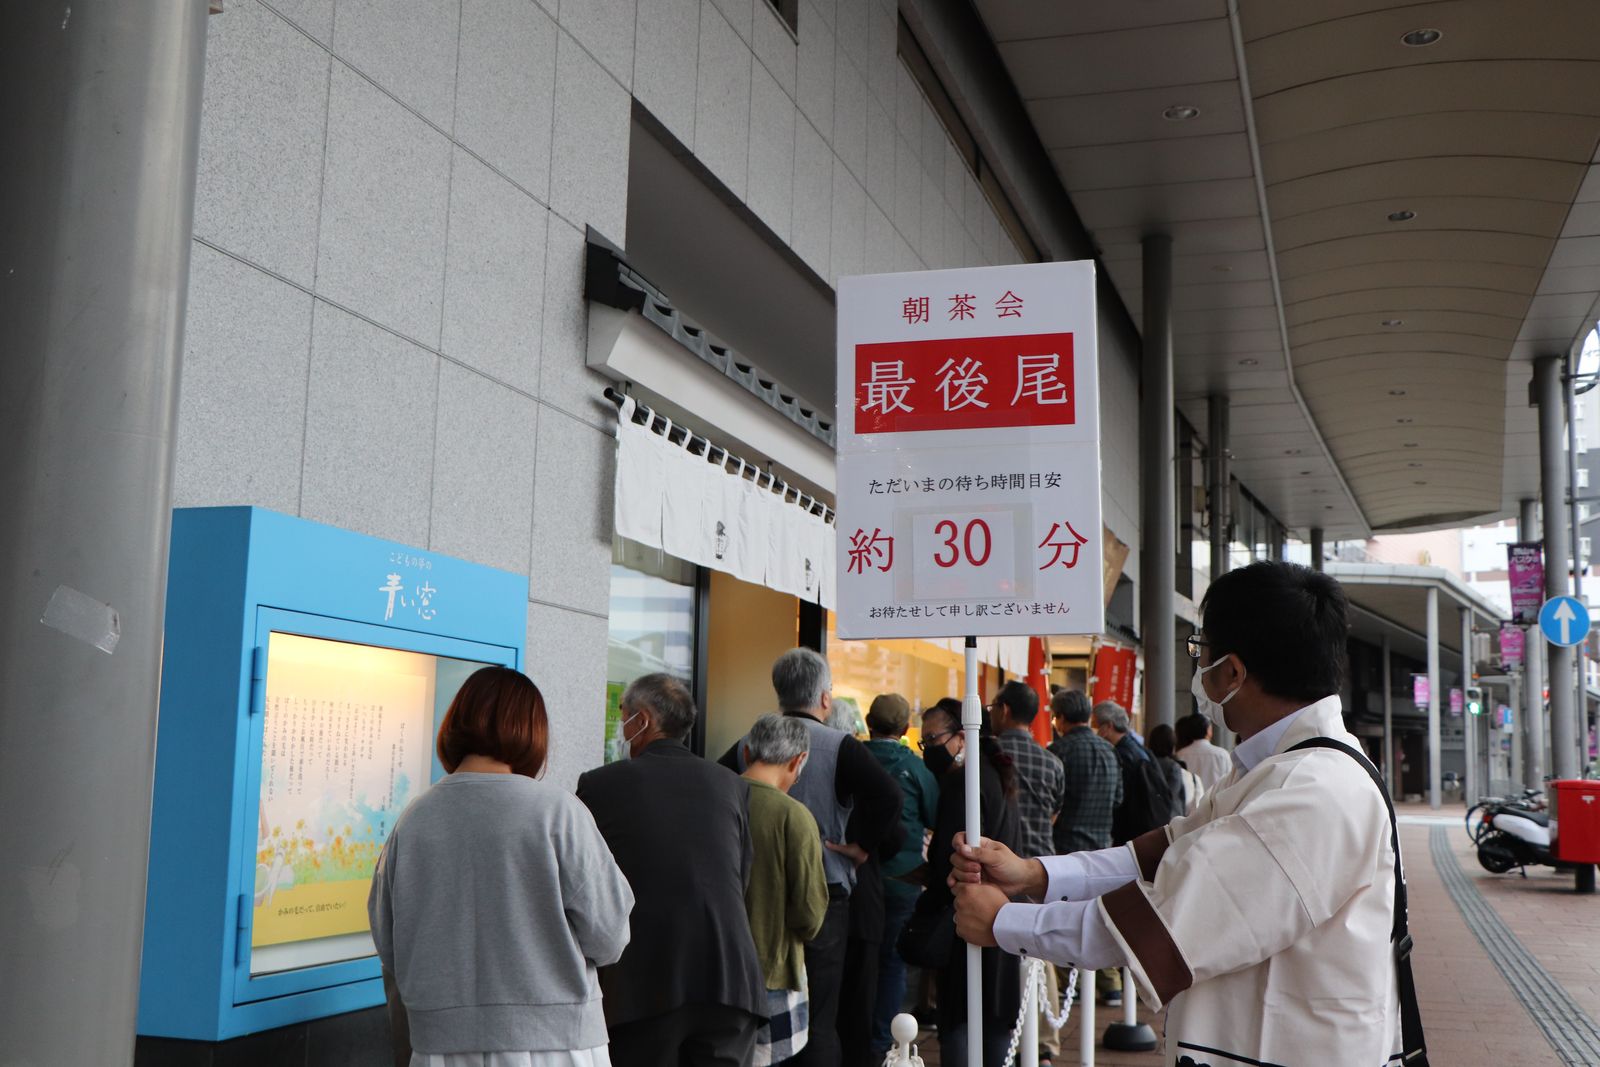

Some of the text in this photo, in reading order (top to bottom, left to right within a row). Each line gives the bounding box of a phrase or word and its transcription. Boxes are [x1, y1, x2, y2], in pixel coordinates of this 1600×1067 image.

[902, 290, 1025, 325] 朝茶会
[860, 352, 1069, 415] 最後尾
[868, 472, 1062, 495] ただいまの待ち時間目安
[846, 527, 895, 575] 約
[933, 518, 993, 569] 30
[1037, 520, 1089, 572] 分
[869, 602, 1071, 620] お待たせして申し訳ございません
